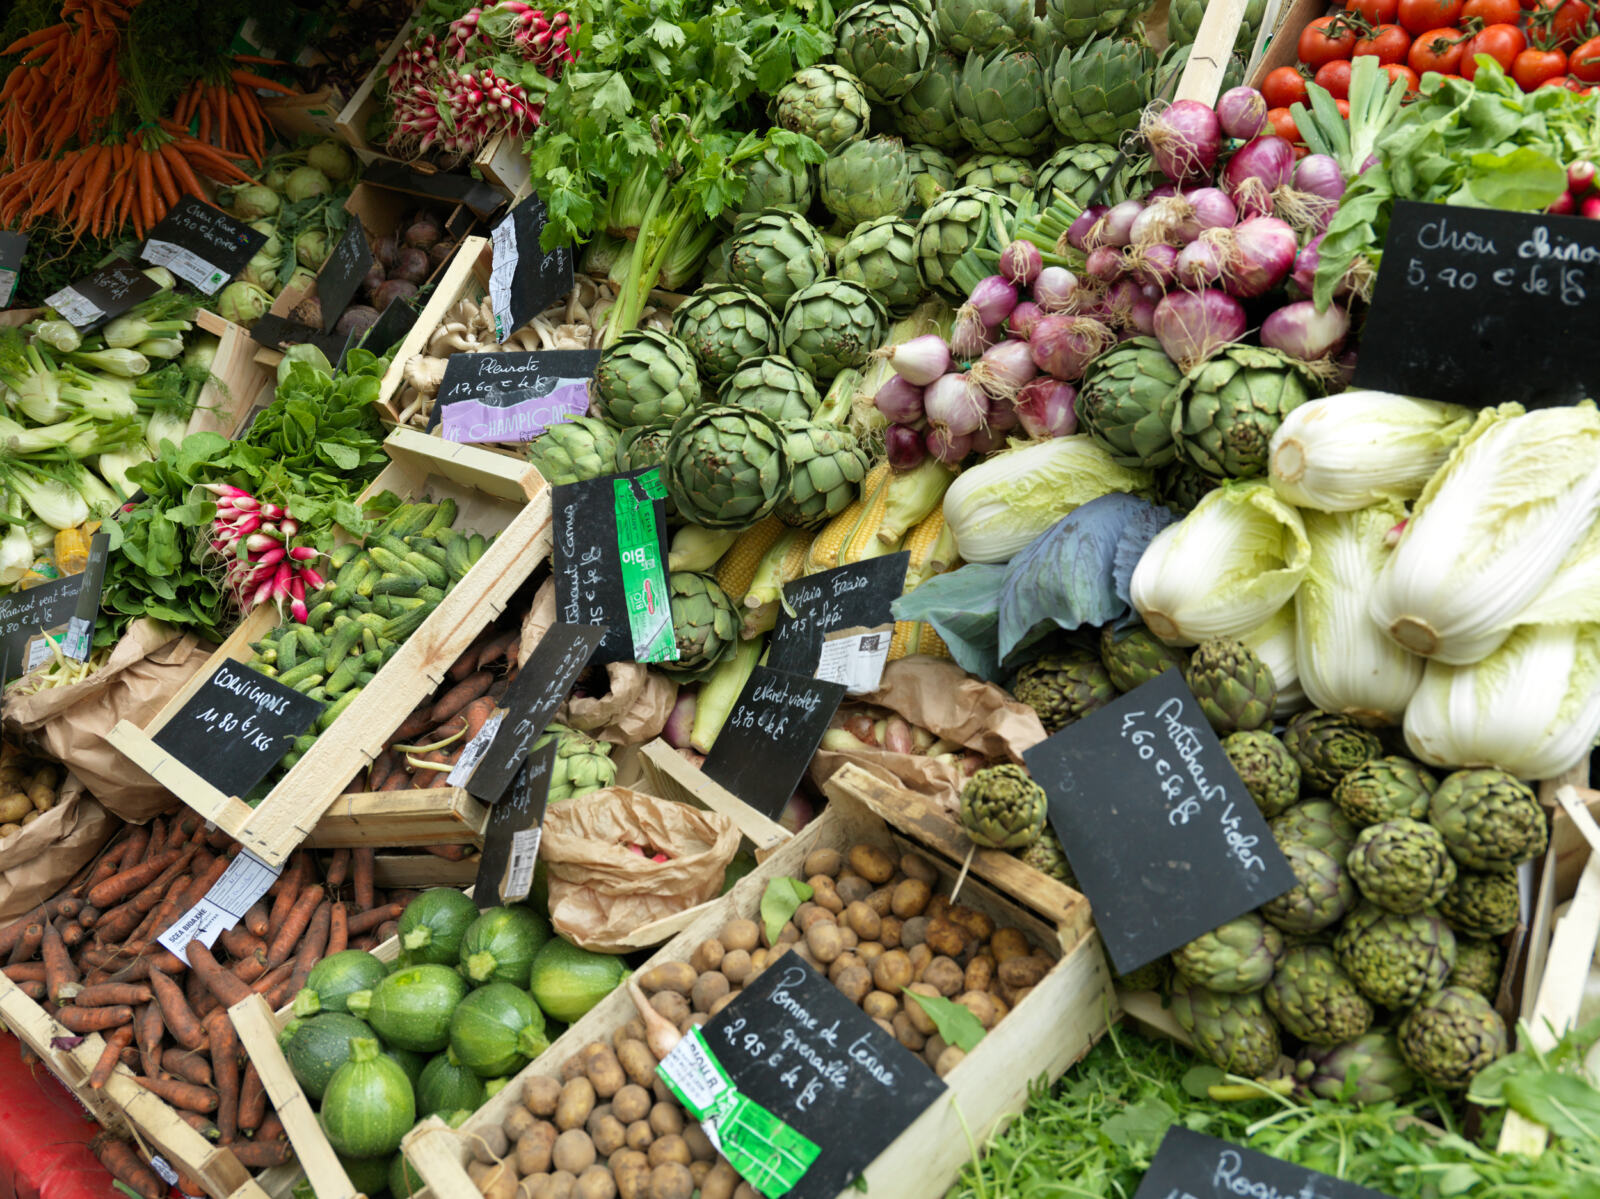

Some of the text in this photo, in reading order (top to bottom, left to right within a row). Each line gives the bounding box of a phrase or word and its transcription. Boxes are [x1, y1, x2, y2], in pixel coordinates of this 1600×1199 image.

[1417, 218, 1498, 254] Chou
[1493, 267, 1516, 286] €
[478, 355, 540, 376] Pleurote
[622, 547, 645, 565] Bio
[767, 966, 819, 1031] Pomme
[820, 1019, 842, 1048] de
